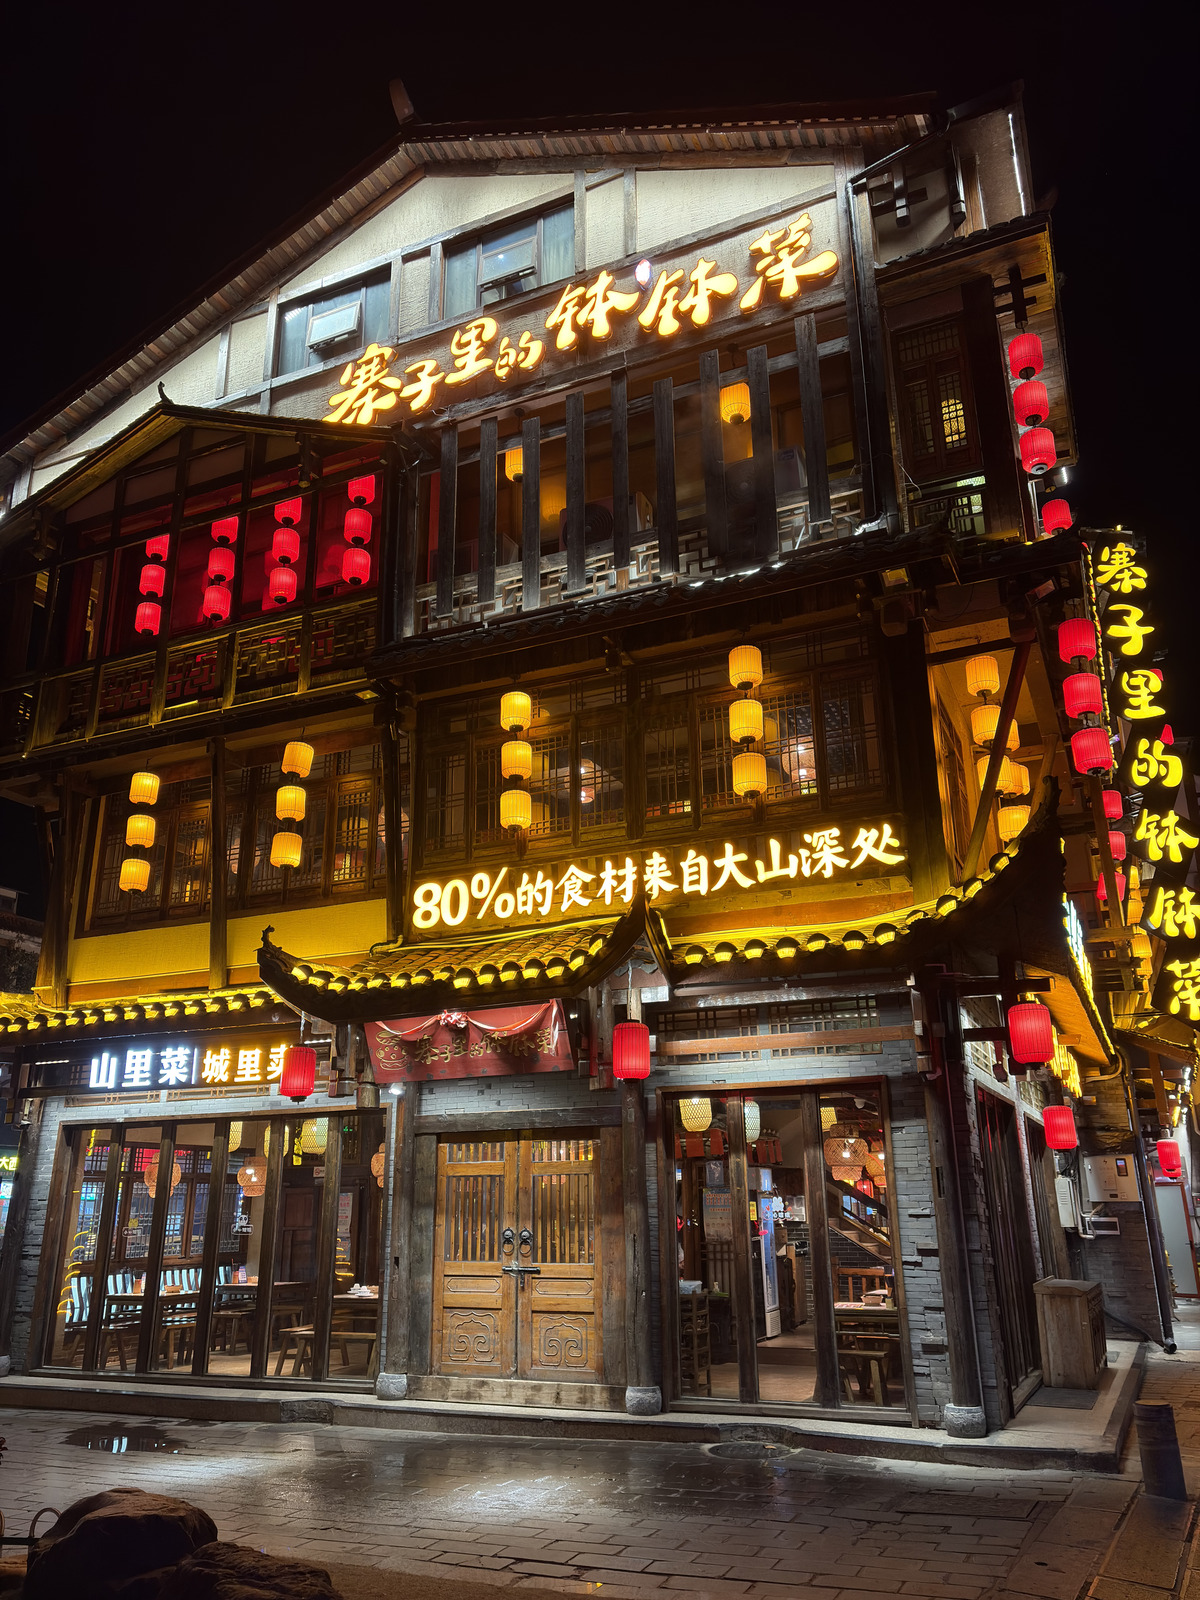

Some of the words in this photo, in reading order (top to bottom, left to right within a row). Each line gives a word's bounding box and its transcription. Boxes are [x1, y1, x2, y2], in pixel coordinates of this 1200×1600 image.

[322, 213, 837, 425] 寨子里的钵钵菜
[412, 824, 905, 930] 80%的食材来自大山深处
